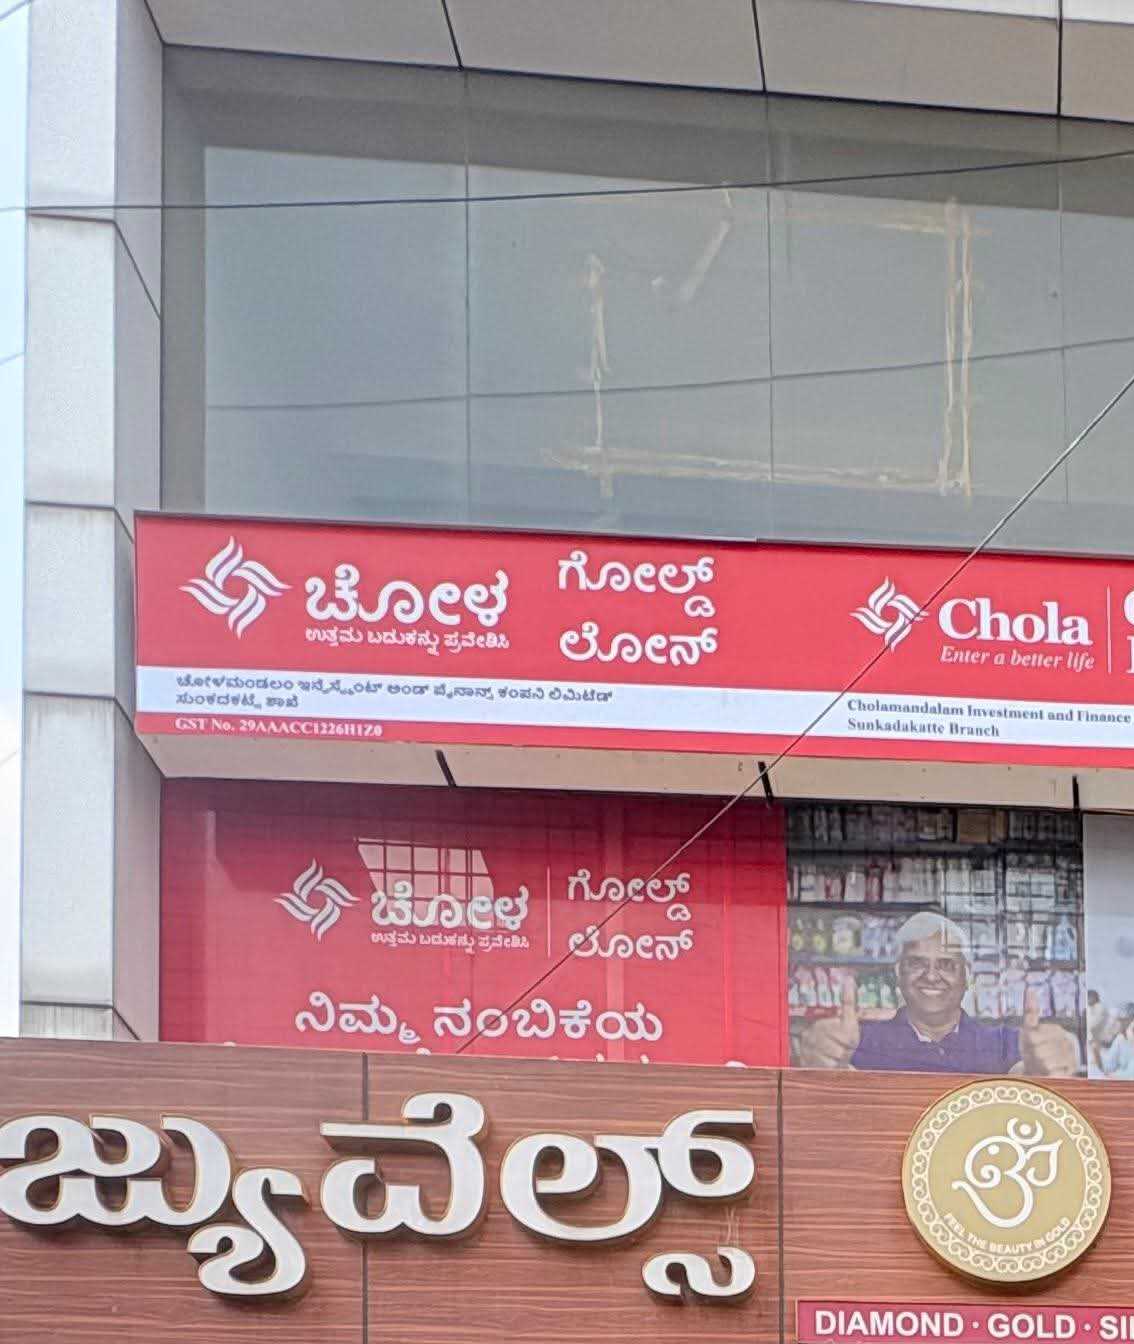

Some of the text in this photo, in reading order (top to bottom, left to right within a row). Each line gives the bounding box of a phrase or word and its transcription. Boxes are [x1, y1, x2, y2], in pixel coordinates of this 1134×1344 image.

[305, 563, 509, 627] ಚೋಳ
[558, 549, 716, 618] ಗೋಲ್ಡ್
[938, 597, 1094, 646] Chola
[559, 621, 719, 666] ಲೋನ್
[940, 645, 1095, 673] Enter a better life
[174, 718, 206, 731] GST
[210, 718, 236, 732] No.
[847, 698, 964, 716] Cholamandalam
[967, 704, 1044, 720] Investment
[1048, 709, 1073, 722] and
[1077, 710, 1131, 724] Finance
[847, 717, 1000, 737] Sunkadakatte Branch
[370, 880, 529, 932] ಚೋಳ
[567, 868, 691, 922] ಗೋಲ್ಡ್
[568, 923, 694, 962] ಲೋನ್
[295, 991, 664, 1044] ನಿಮ್ಮ ನಂಬಿಕೆಯ
[989, 1240, 1033, 1255] BEAUTY
[815, 1310, 964, 1338] DIAMOND
[987, 1313, 1076, 1339] GOLD
